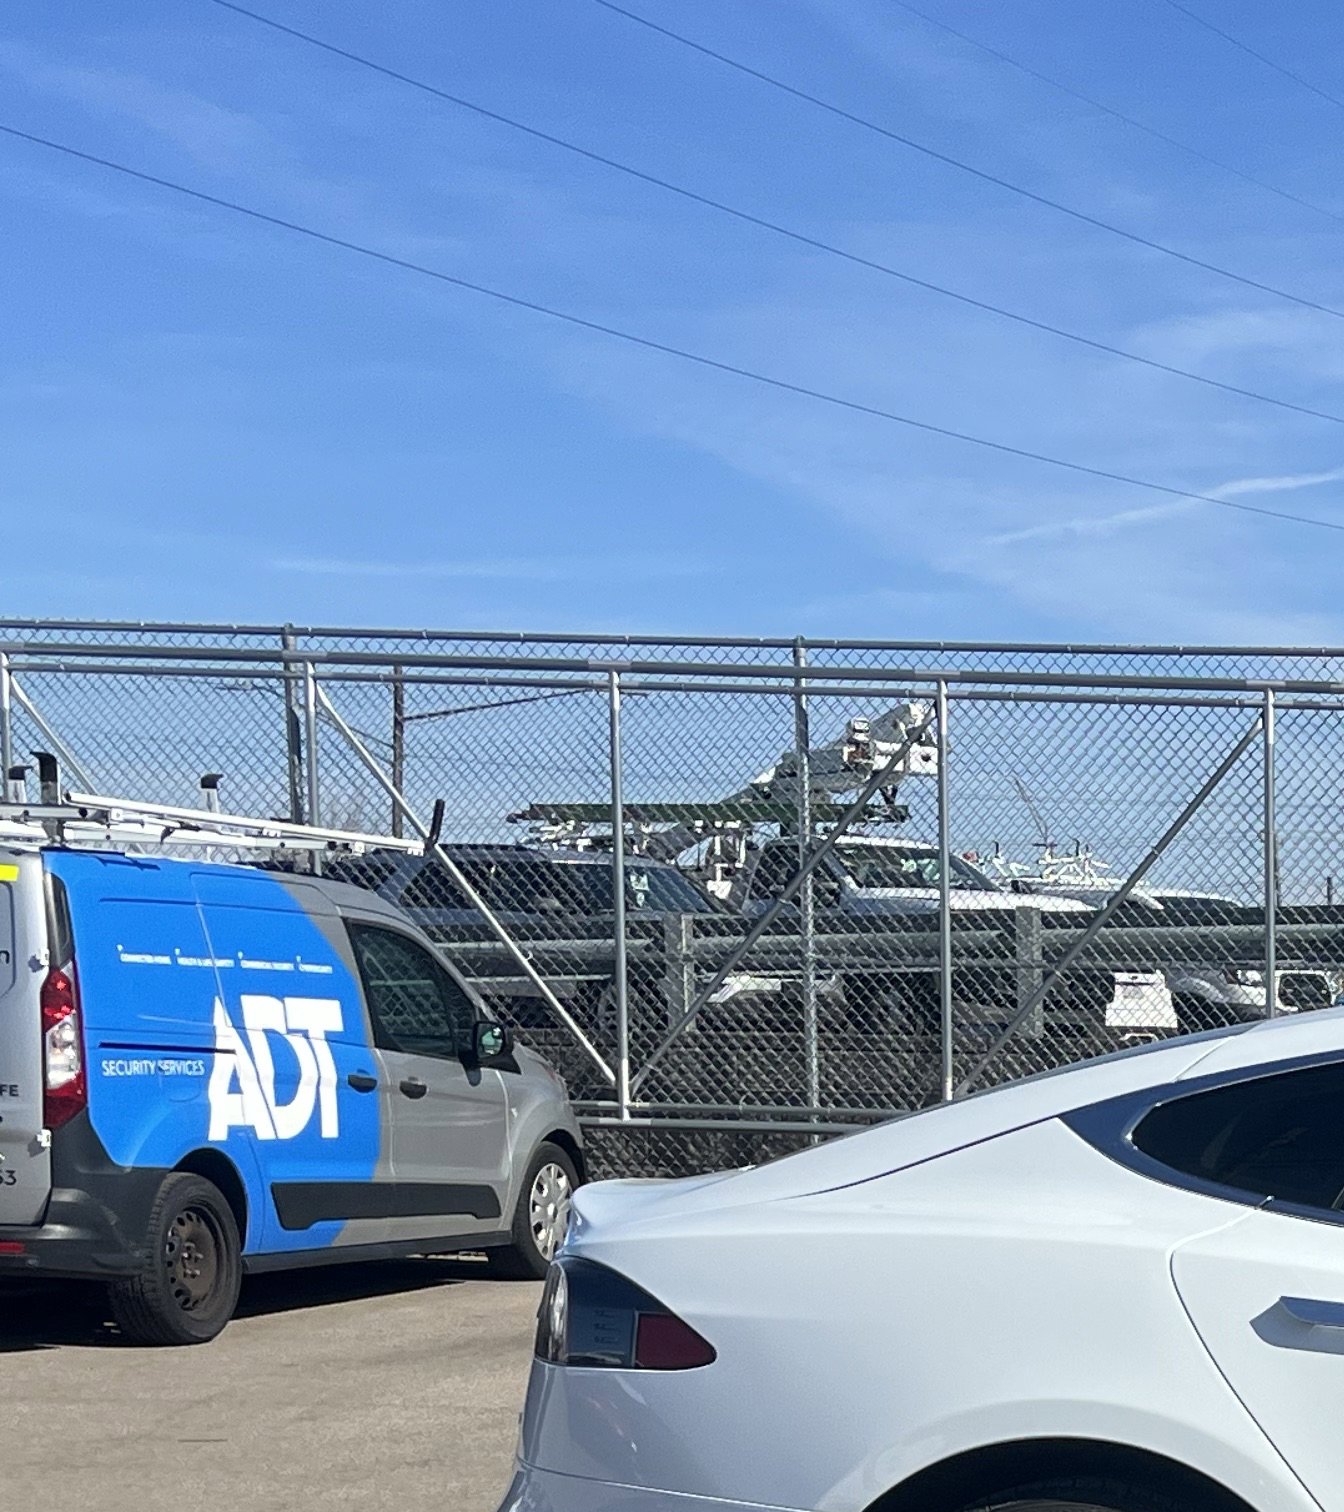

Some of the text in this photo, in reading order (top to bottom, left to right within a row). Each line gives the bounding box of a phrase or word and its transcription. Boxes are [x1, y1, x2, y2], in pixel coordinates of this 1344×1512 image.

[101, 1059, 205, 1077] SECURITY SERVICES
[208, 994, 344, 1141] ADT
